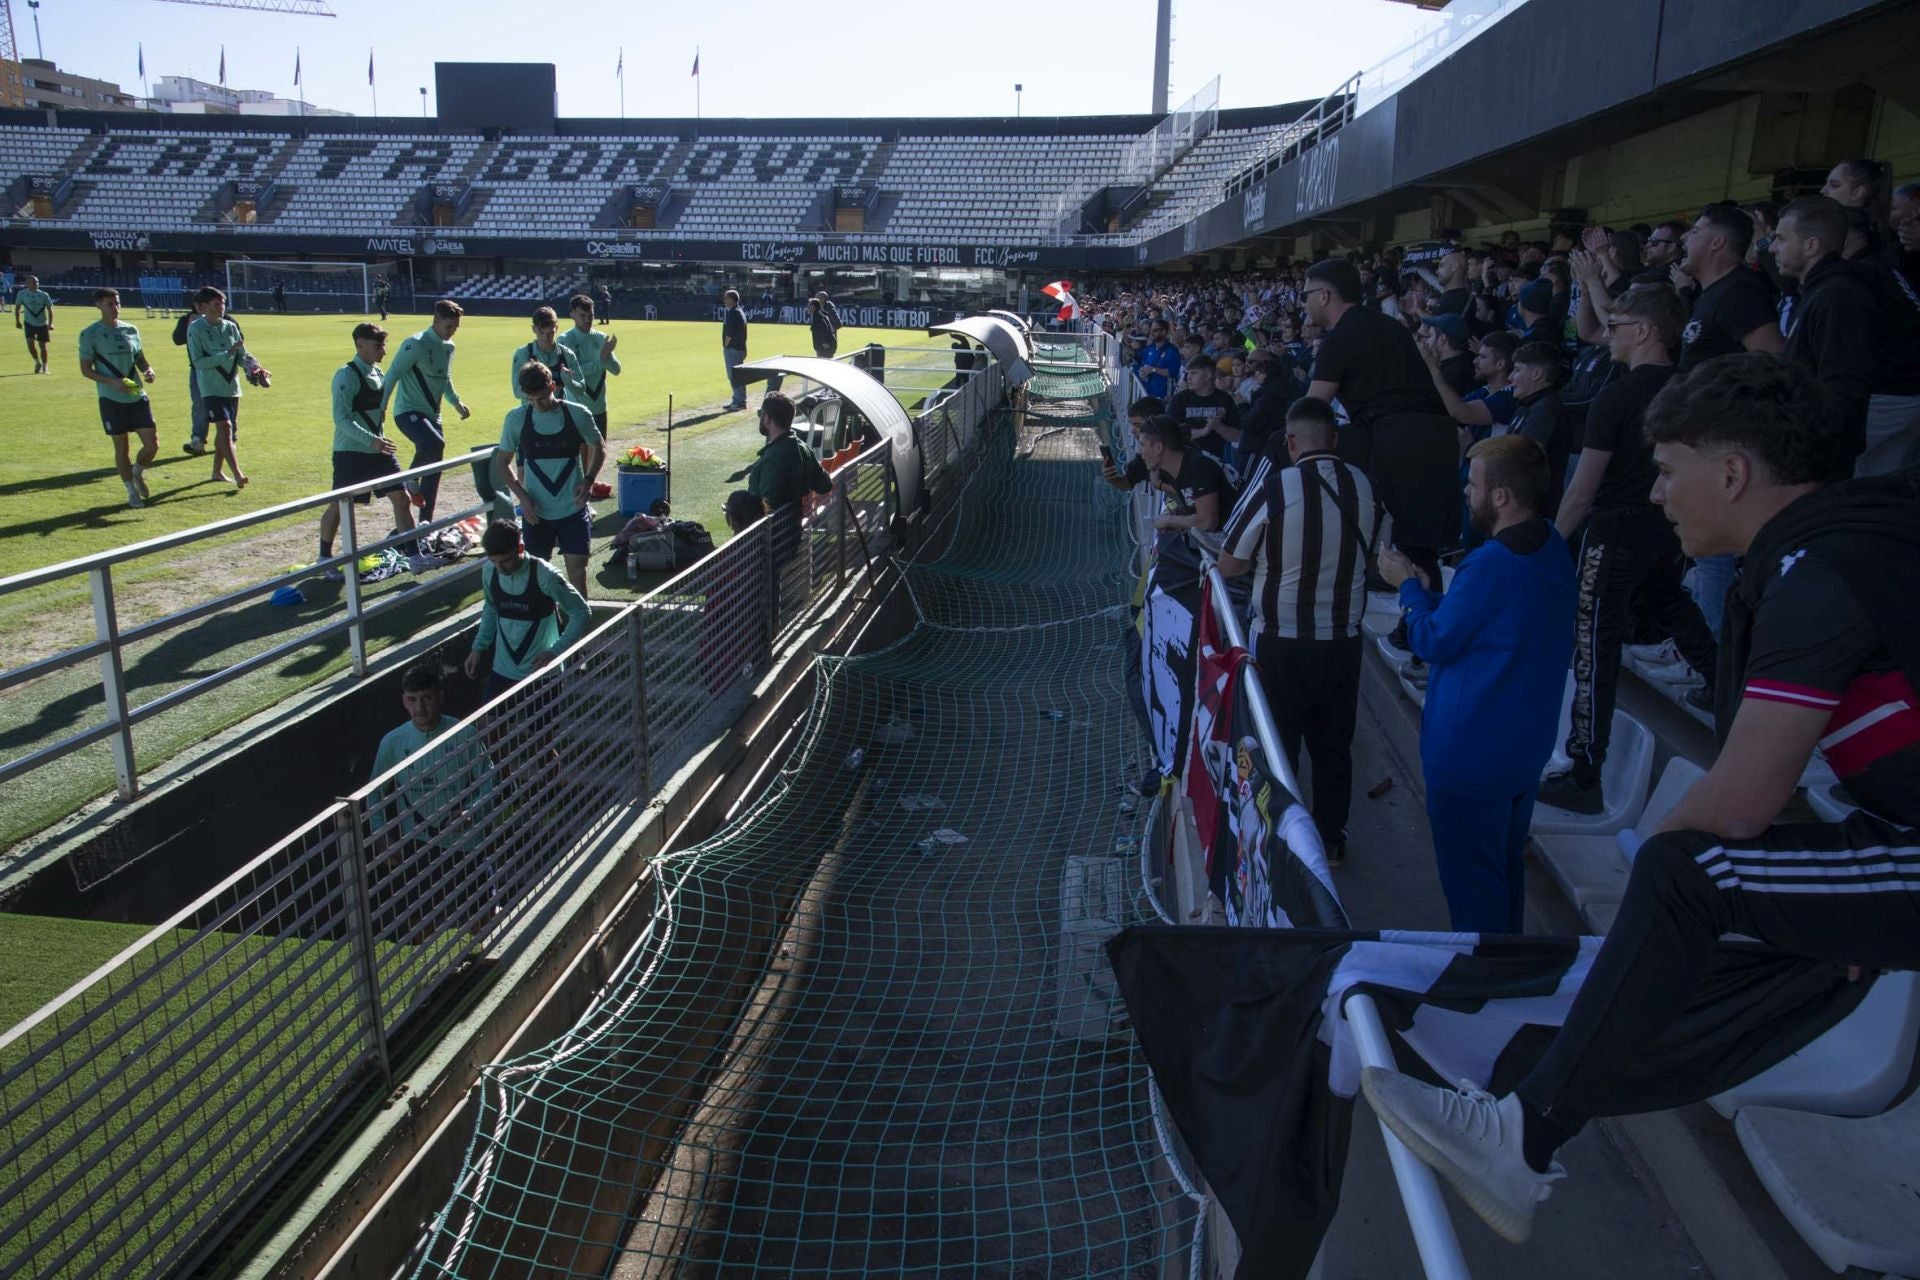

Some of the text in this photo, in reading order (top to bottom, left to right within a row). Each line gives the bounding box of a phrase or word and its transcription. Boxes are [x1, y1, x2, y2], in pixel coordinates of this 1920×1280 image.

[89, 231, 137, 240] MUDANZAS
[94, 239, 134, 249] MOFLY
[367, 238, 415, 251] AVATEL
[437, 242, 464, 250] CAESA
[598, 242, 641, 254] Castellini
[742, 243, 761, 260] FCC
[818, 245, 858, 261] MUCHO
[890, 247, 913, 263] QUE
[975, 247, 994, 265] FCC
[860, 309, 883, 326] QUE
